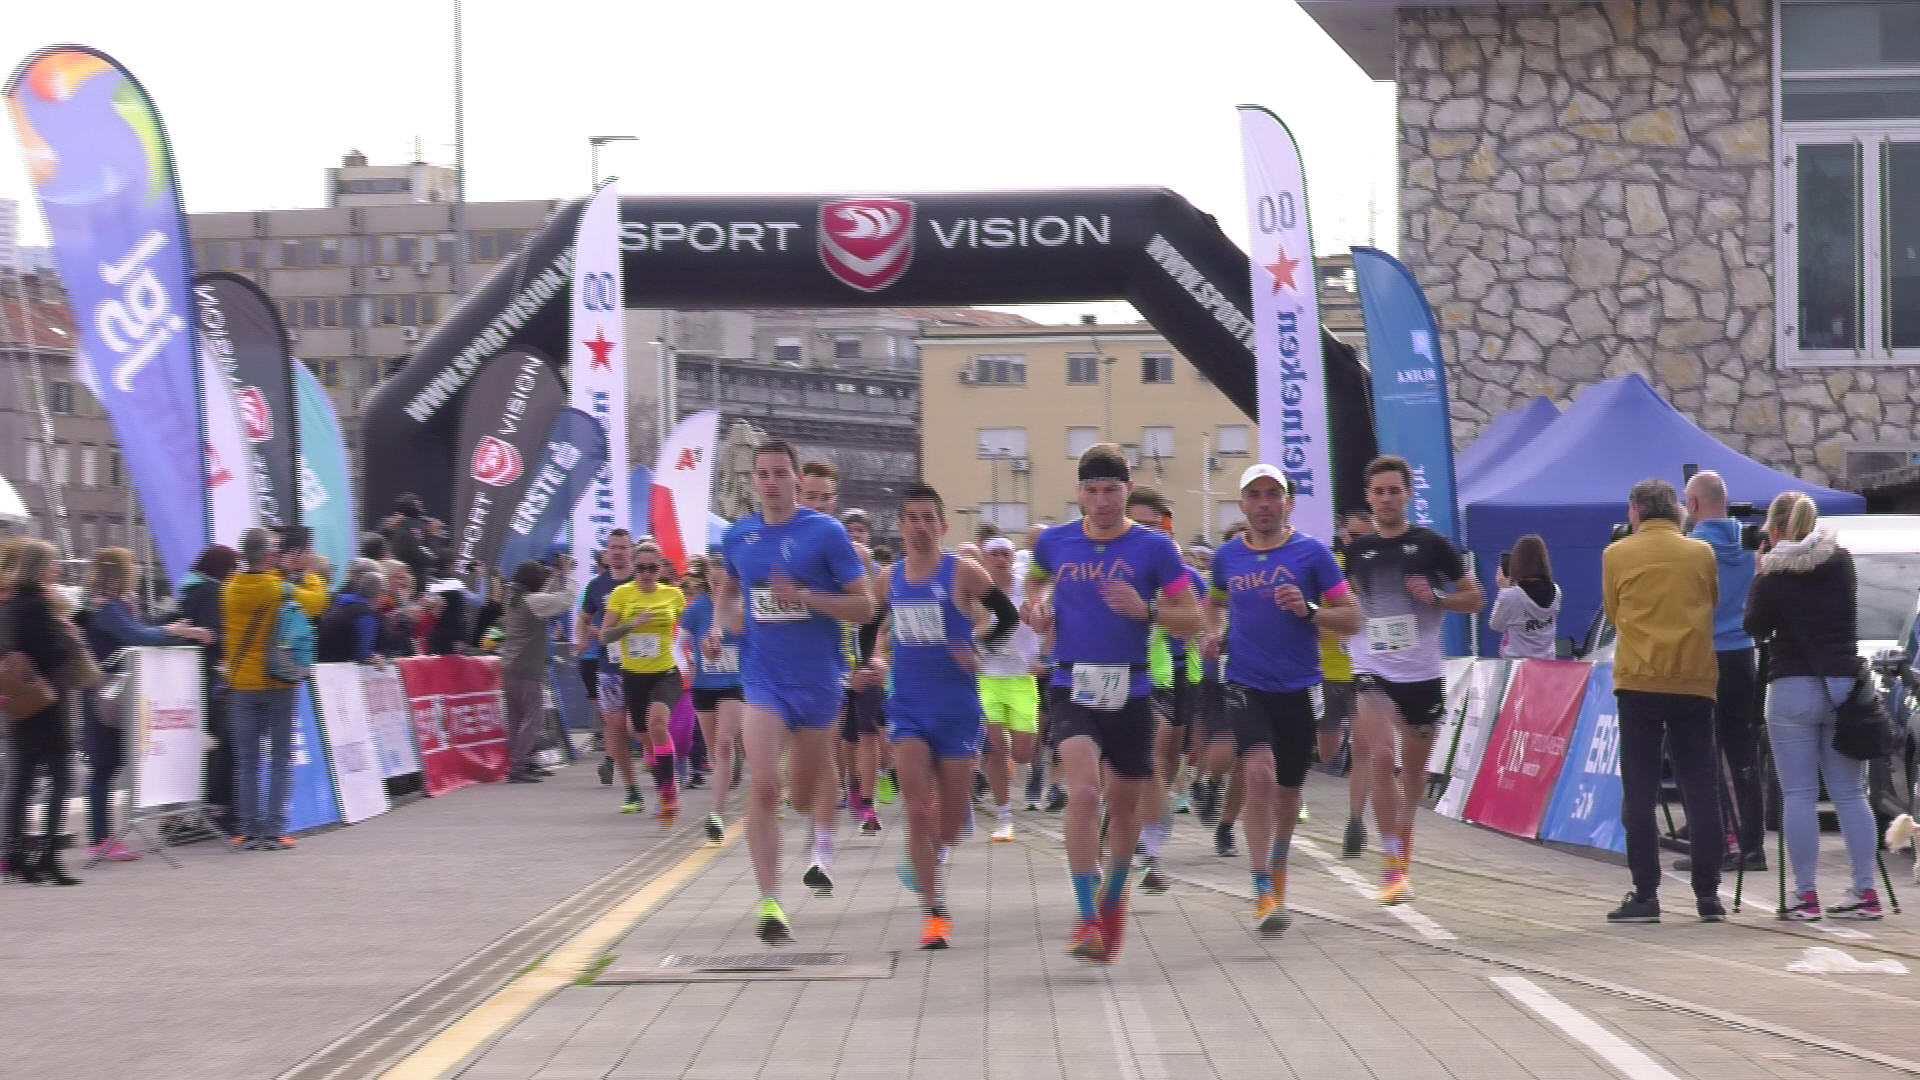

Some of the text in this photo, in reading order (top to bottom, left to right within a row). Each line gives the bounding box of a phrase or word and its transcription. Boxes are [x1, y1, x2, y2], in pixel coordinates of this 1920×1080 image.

[618, 214, 1111, 252] SPORT VISION
[1145, 232, 1258, 356] WWW.SPORTV
[499, 356, 545, 435] VISION
[674, 446, 704, 471] A1
[509, 463, 567, 538] ERSTE
[1055, 558, 1135, 585] RIKA
[1226, 564, 1297, 592] RIKA
[1101, 672, 1121, 693] 77
[1584, 715, 1622, 776] ERST
